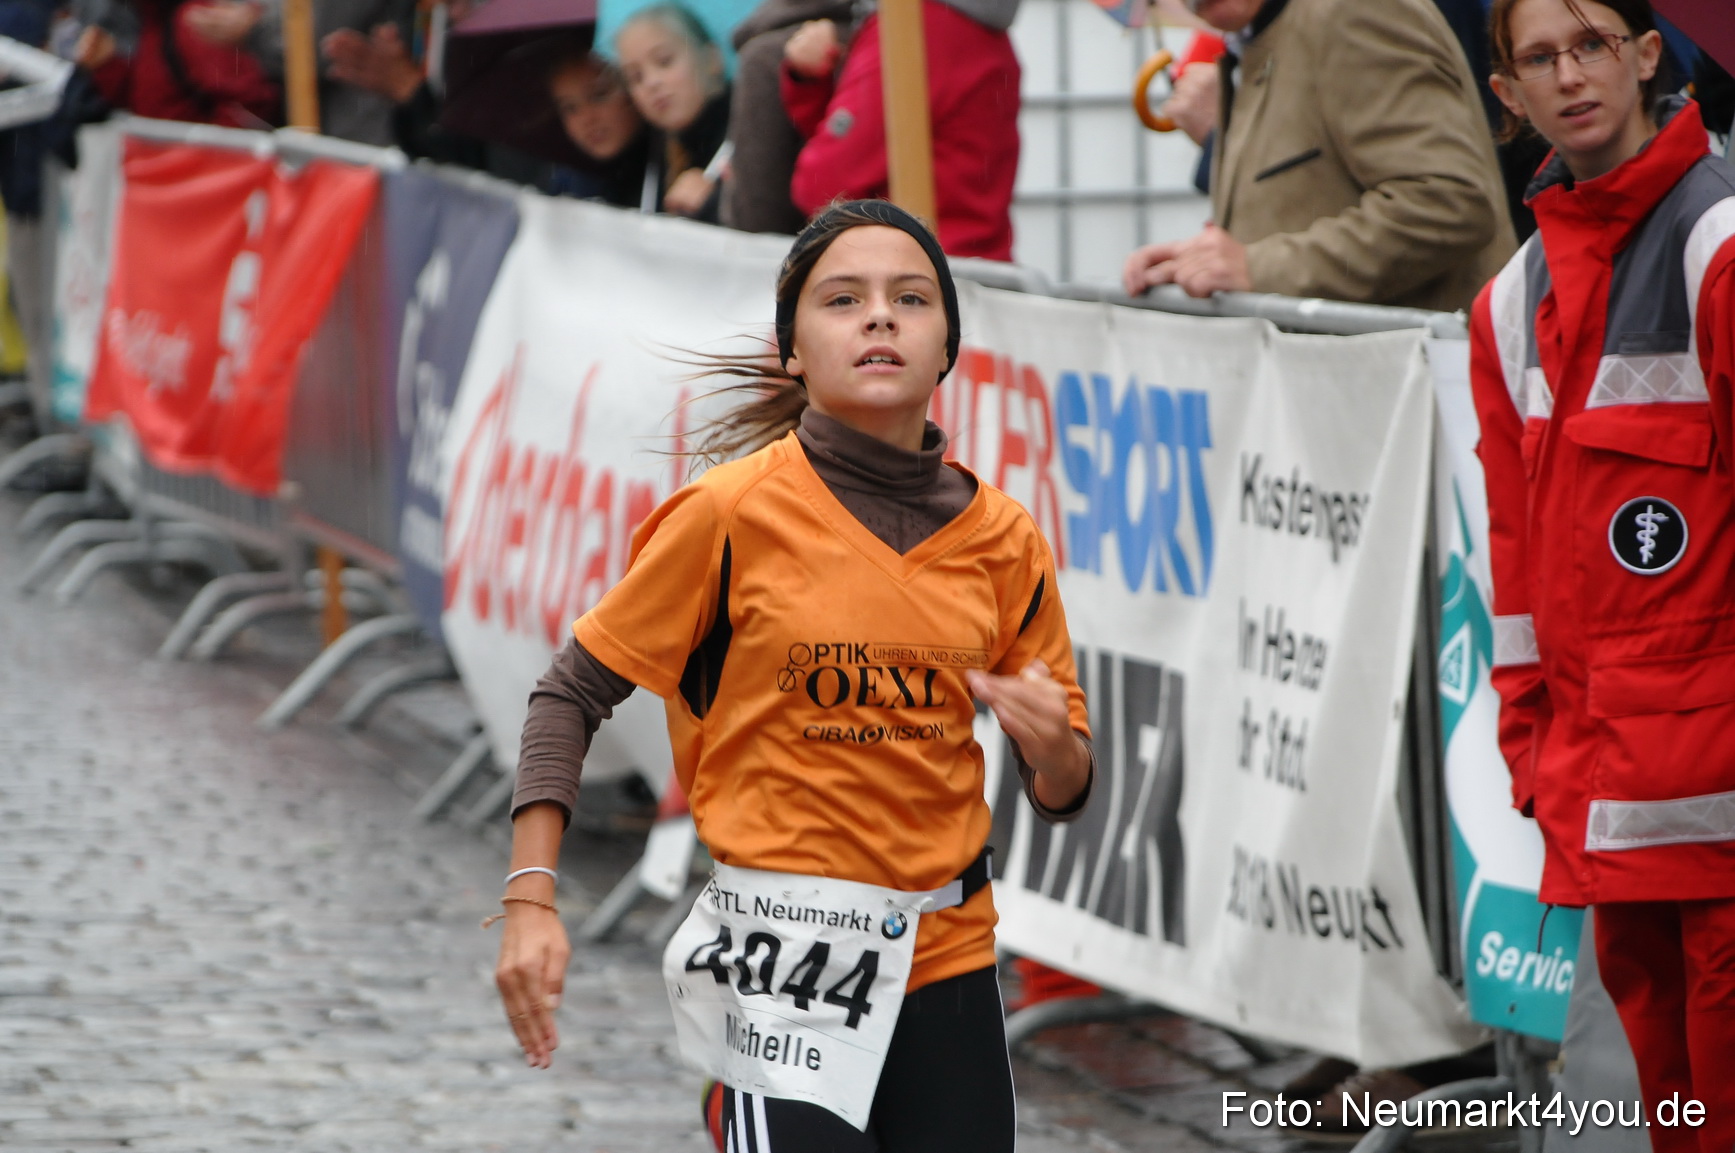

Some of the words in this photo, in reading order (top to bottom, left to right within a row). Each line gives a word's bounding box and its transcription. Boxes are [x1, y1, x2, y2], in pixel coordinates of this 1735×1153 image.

[789, 643, 870, 666] OPTIK
[873, 648, 918, 661] UHREN
[921, 650, 948, 662] UND
[805, 666, 947, 709] OEXL
[754, 894, 873, 932] Neumarkt
[685, 923, 880, 1031] 4044
[726, 1013, 822, 1071] Michelle
